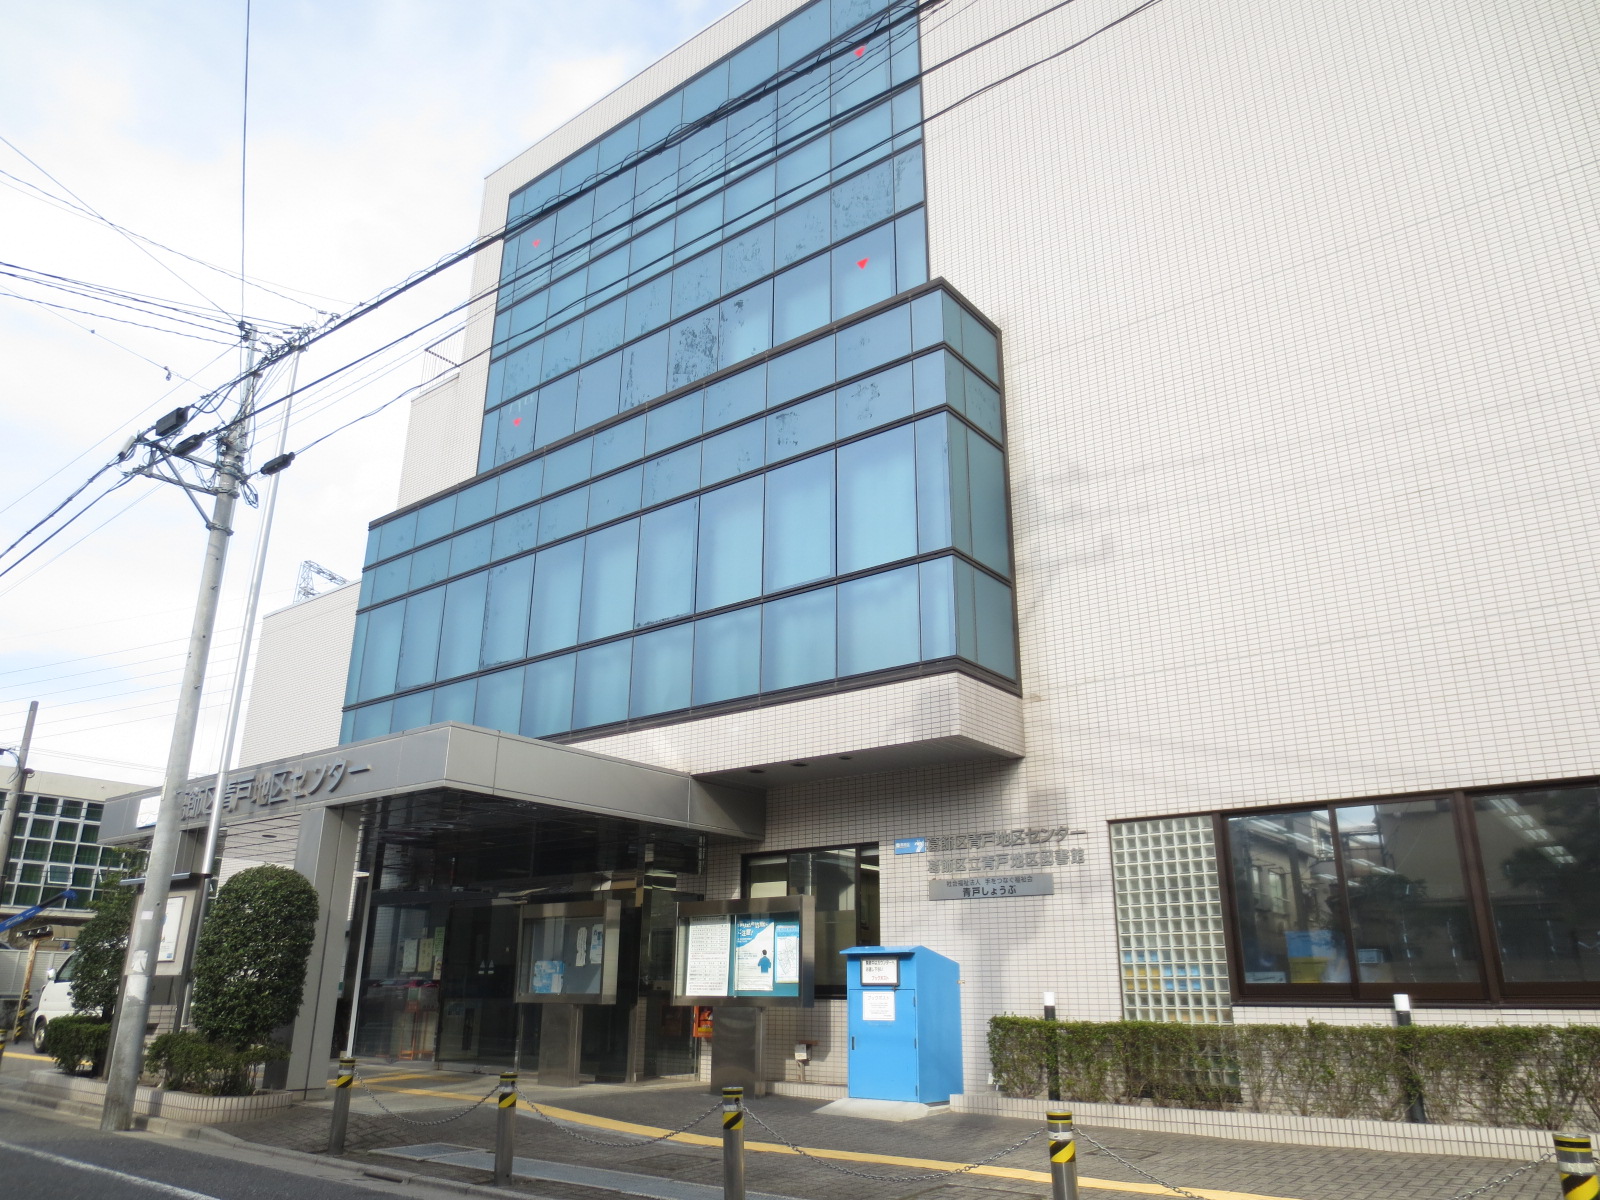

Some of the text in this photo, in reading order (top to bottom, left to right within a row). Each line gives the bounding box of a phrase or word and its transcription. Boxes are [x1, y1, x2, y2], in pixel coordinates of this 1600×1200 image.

[177, 759, 371, 821] 飾区青戸地区センター
[927, 826, 1086, 852] 葛飾区青戸地区センター
[927, 848, 1085, 873] 葛飾区立青戸地区図書館
[946, 876, 1033, 888] 社会福祉法人 手をつなぐ福祉会
[963, 885, 1016, 898] 青戸しょうぶ
